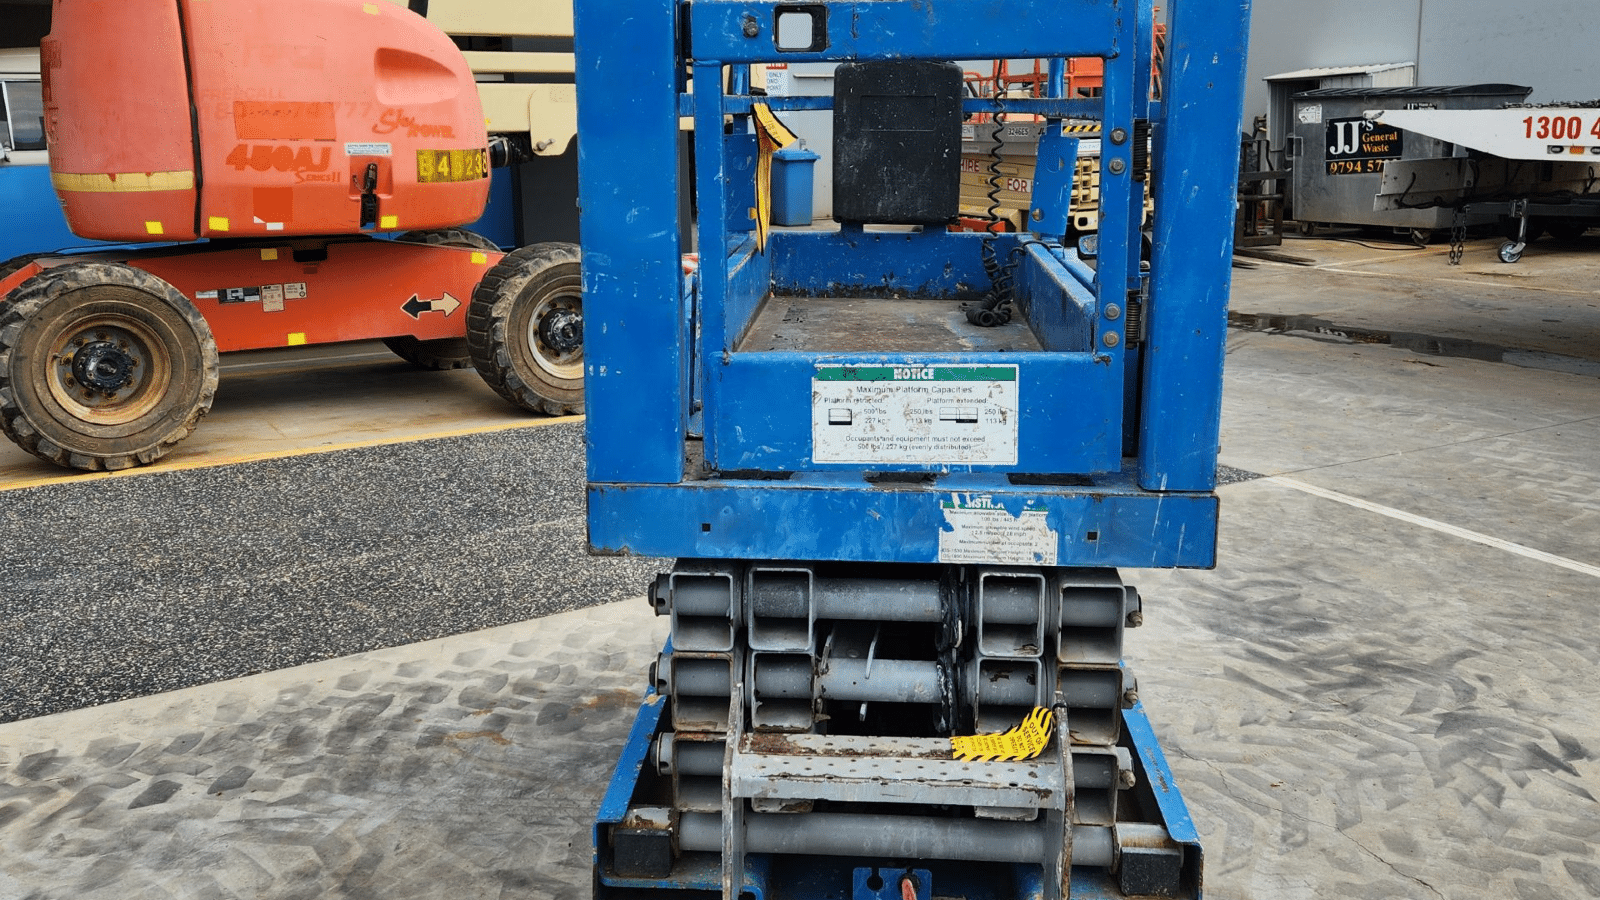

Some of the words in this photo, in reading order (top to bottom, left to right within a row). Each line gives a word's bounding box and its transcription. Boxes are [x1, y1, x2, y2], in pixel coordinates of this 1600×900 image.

[1007, 127, 1029, 136] 3246ES
[1523, 115, 1582, 140] 1300
[1361, 131, 1398, 143] General
[1362, 143, 1390, 153] Waste
[225, 143, 333, 174] 450AJ
[1330, 160, 1362, 174] 9794
[1007, 178, 1028, 193] FOR
[893, 368, 935, 380] NOTICE
[856, 385, 894, 394] Maximum
[896, 385, 929, 394] Platform
[931, 385, 973, 395] Capacities
[845, 435, 880, 443] Occupants
[1029, 722, 1040, 737] OUT
[1022, 726, 1036, 752] SERVICE
